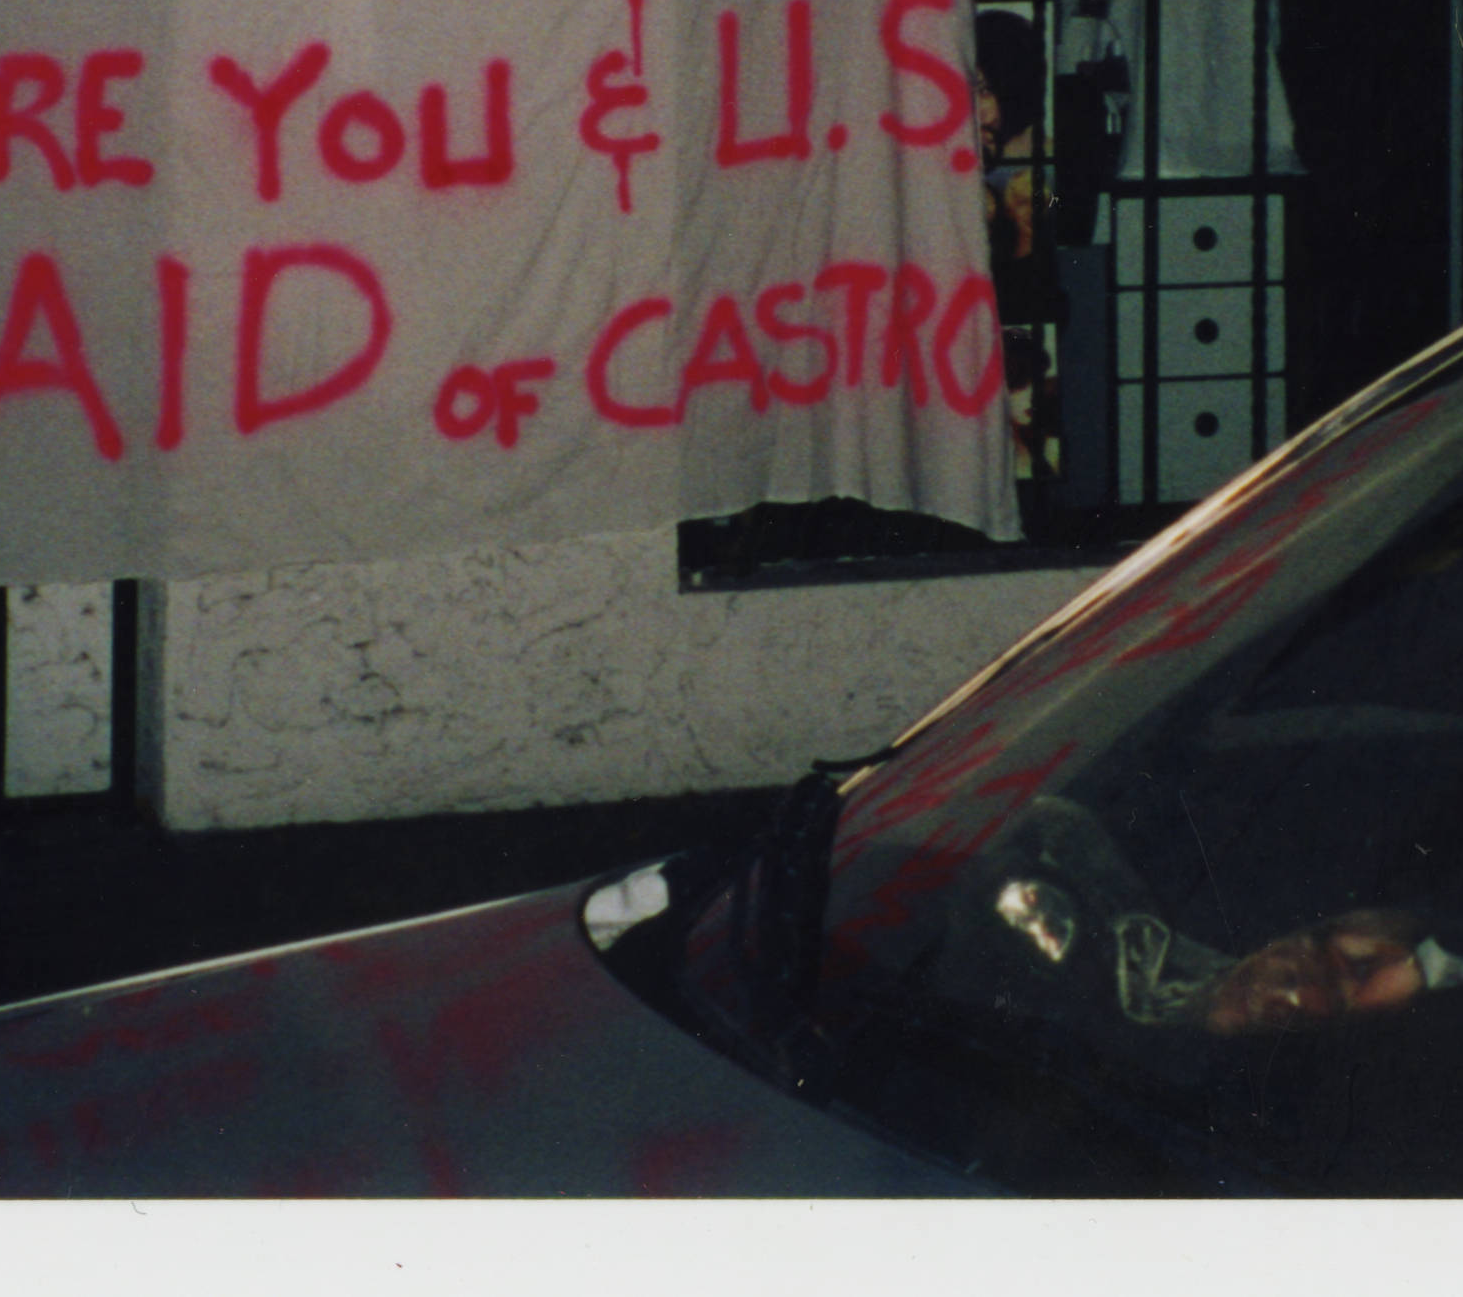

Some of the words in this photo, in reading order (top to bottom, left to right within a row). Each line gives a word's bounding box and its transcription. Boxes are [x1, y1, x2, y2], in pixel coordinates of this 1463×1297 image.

[206, 40, 516, 204] YOU
[433, 357, 556, 449] OF
[584, 260, 1003, 428] CASTRO
